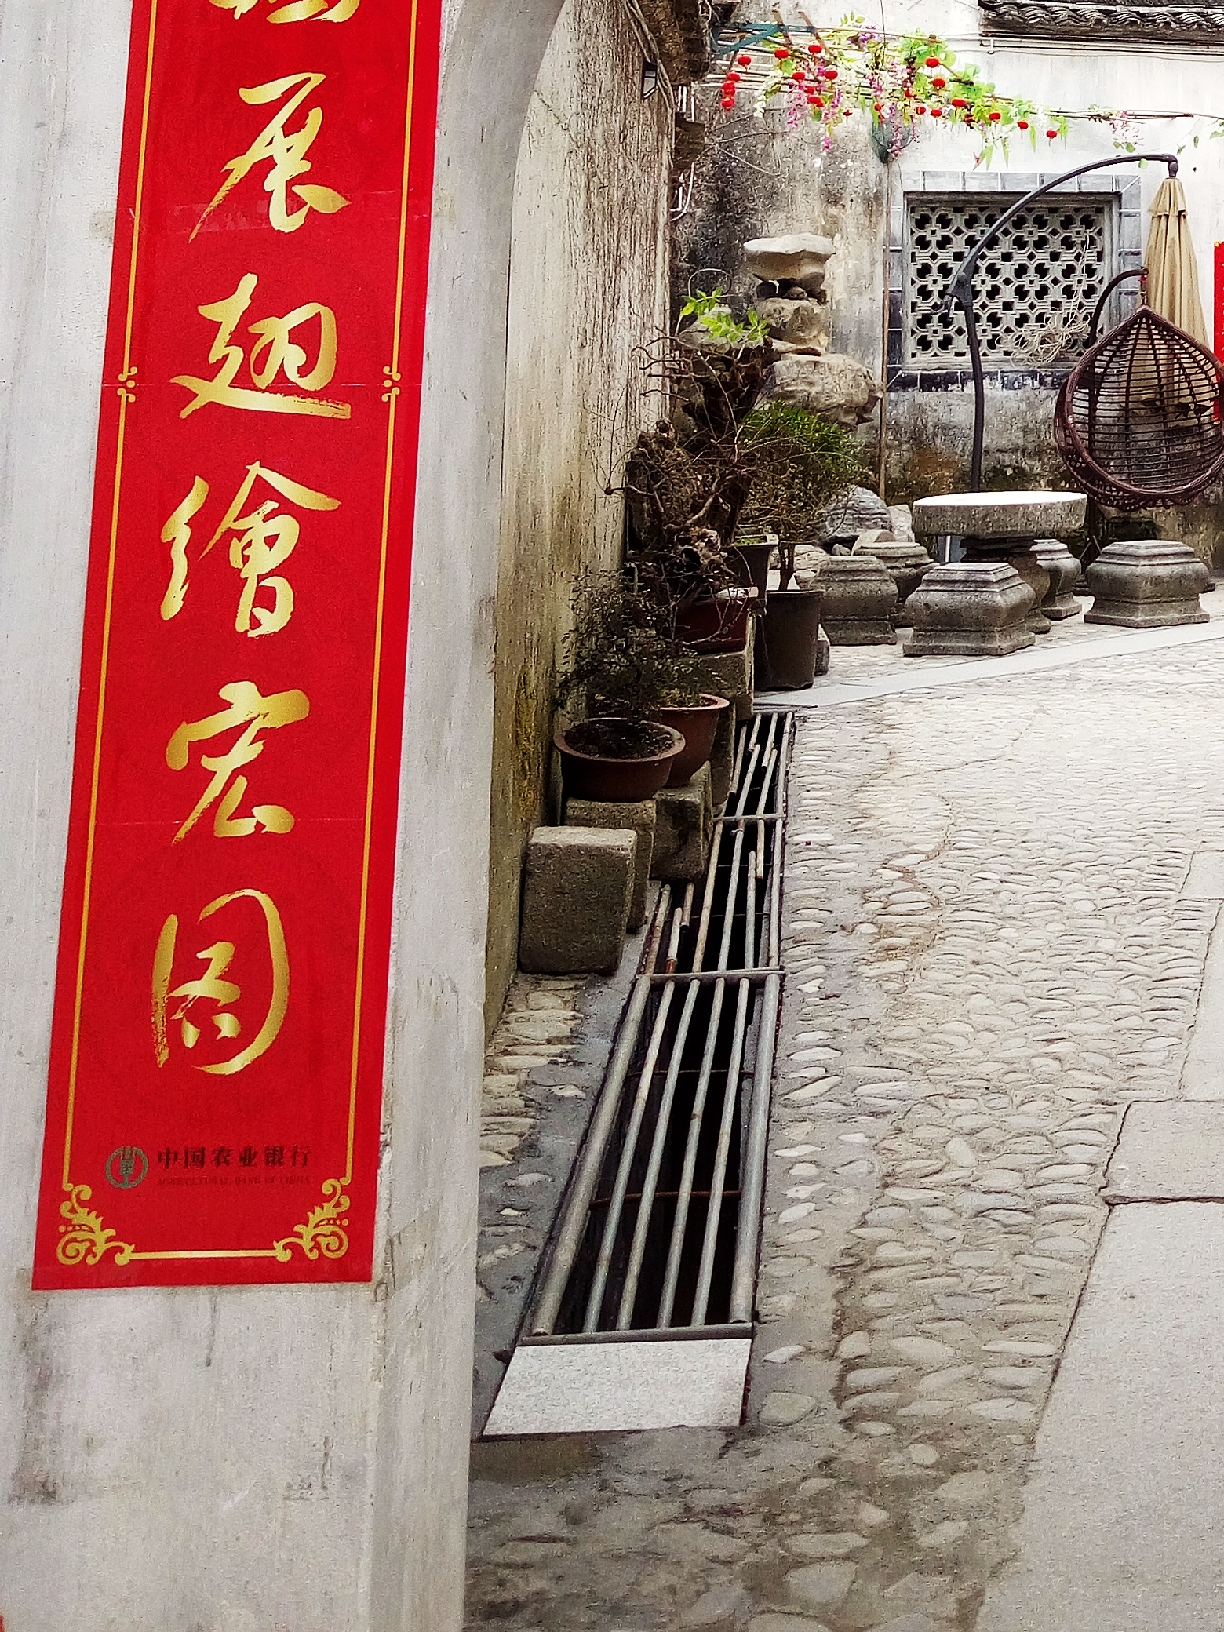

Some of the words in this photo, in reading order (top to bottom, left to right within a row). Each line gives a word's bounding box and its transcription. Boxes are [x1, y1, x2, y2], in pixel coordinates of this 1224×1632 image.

[157, 1145, 311, 1169] 中国农业银行
